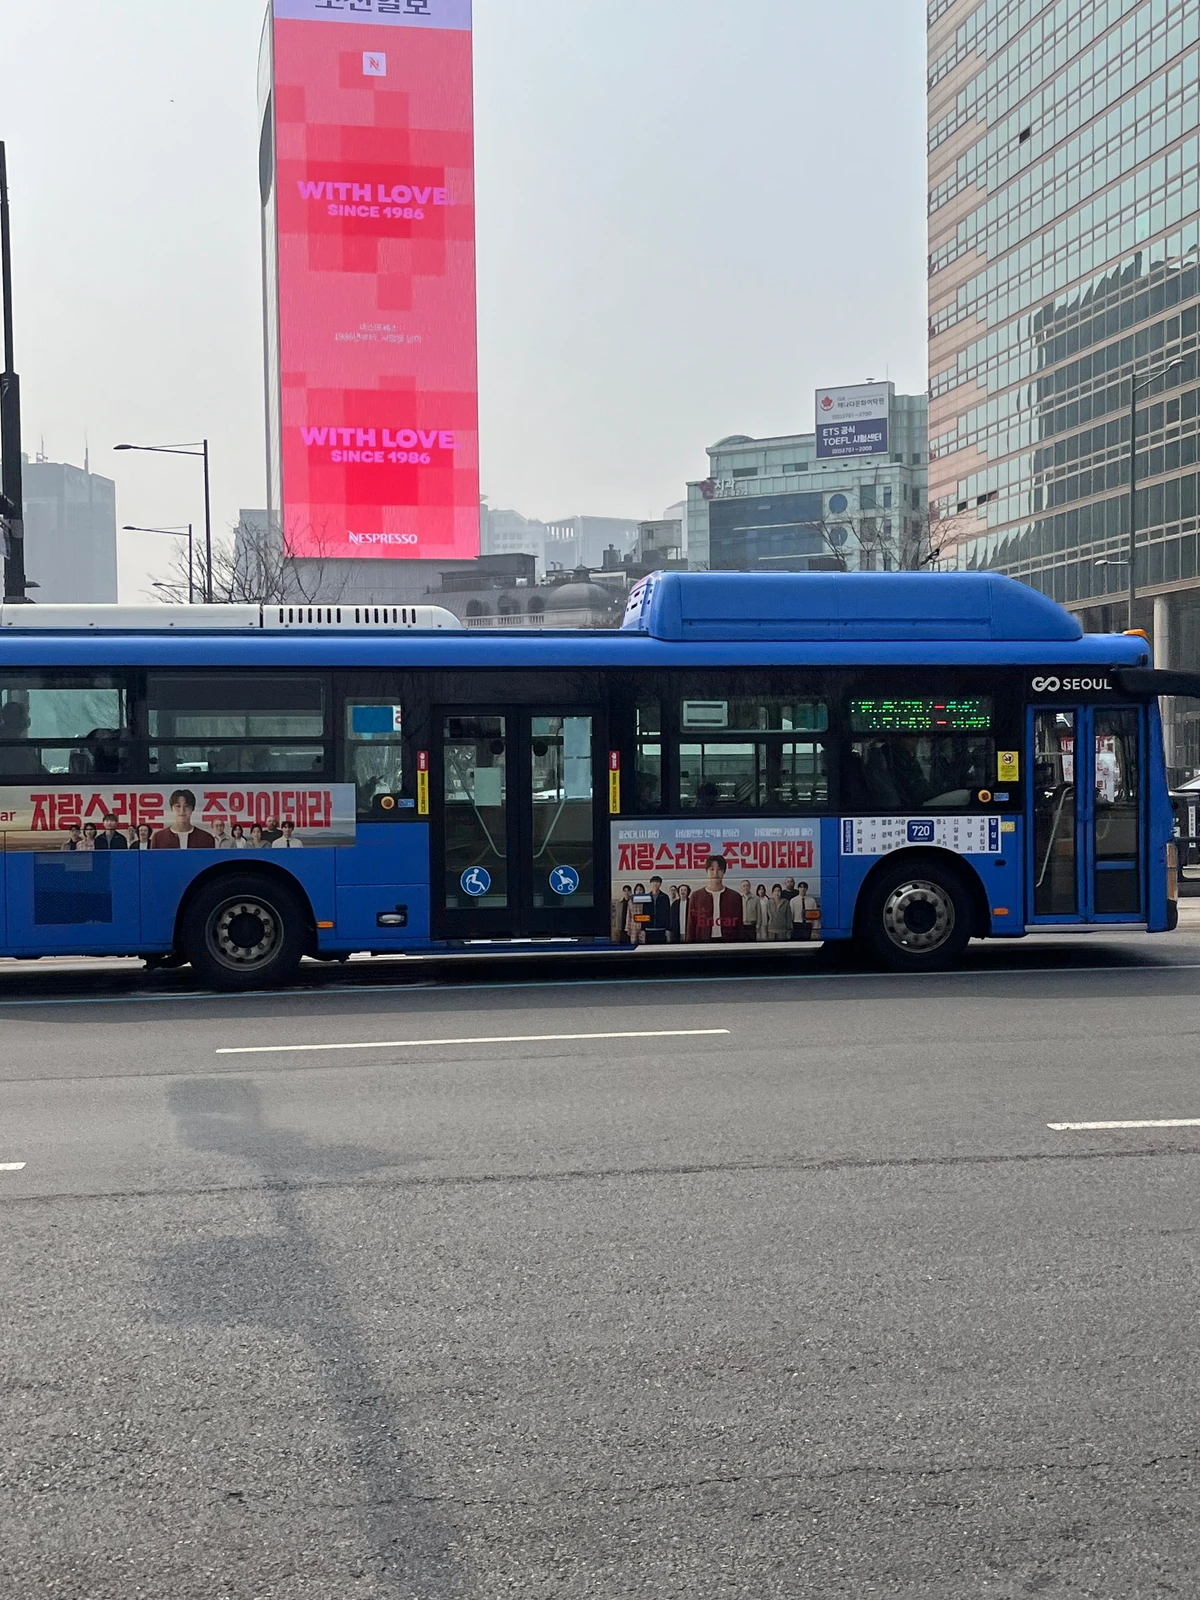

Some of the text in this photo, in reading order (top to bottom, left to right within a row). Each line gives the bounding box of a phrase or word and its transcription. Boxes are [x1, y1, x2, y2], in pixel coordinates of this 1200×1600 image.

[297, 180, 371, 201] WITH
[327, 204, 425, 220] SINCE 1986
[300, 426, 376, 447] WITH
[823, 425, 856, 437] ETS 공식
[823, 432, 882, 446] TOEFL 시험센터
[331, 450, 431, 465] SINCE 1986
[713, 477, 735, 491] 치과
[347, 530, 418, 546] NESPRESSO
[1062, 678, 1112, 690] SEOUL
[30, 792, 164, 830] 자랑스러운
[912, 825, 930, 836] 720
[618, 840, 814, 870] 자랑스러운 주인이돼라
